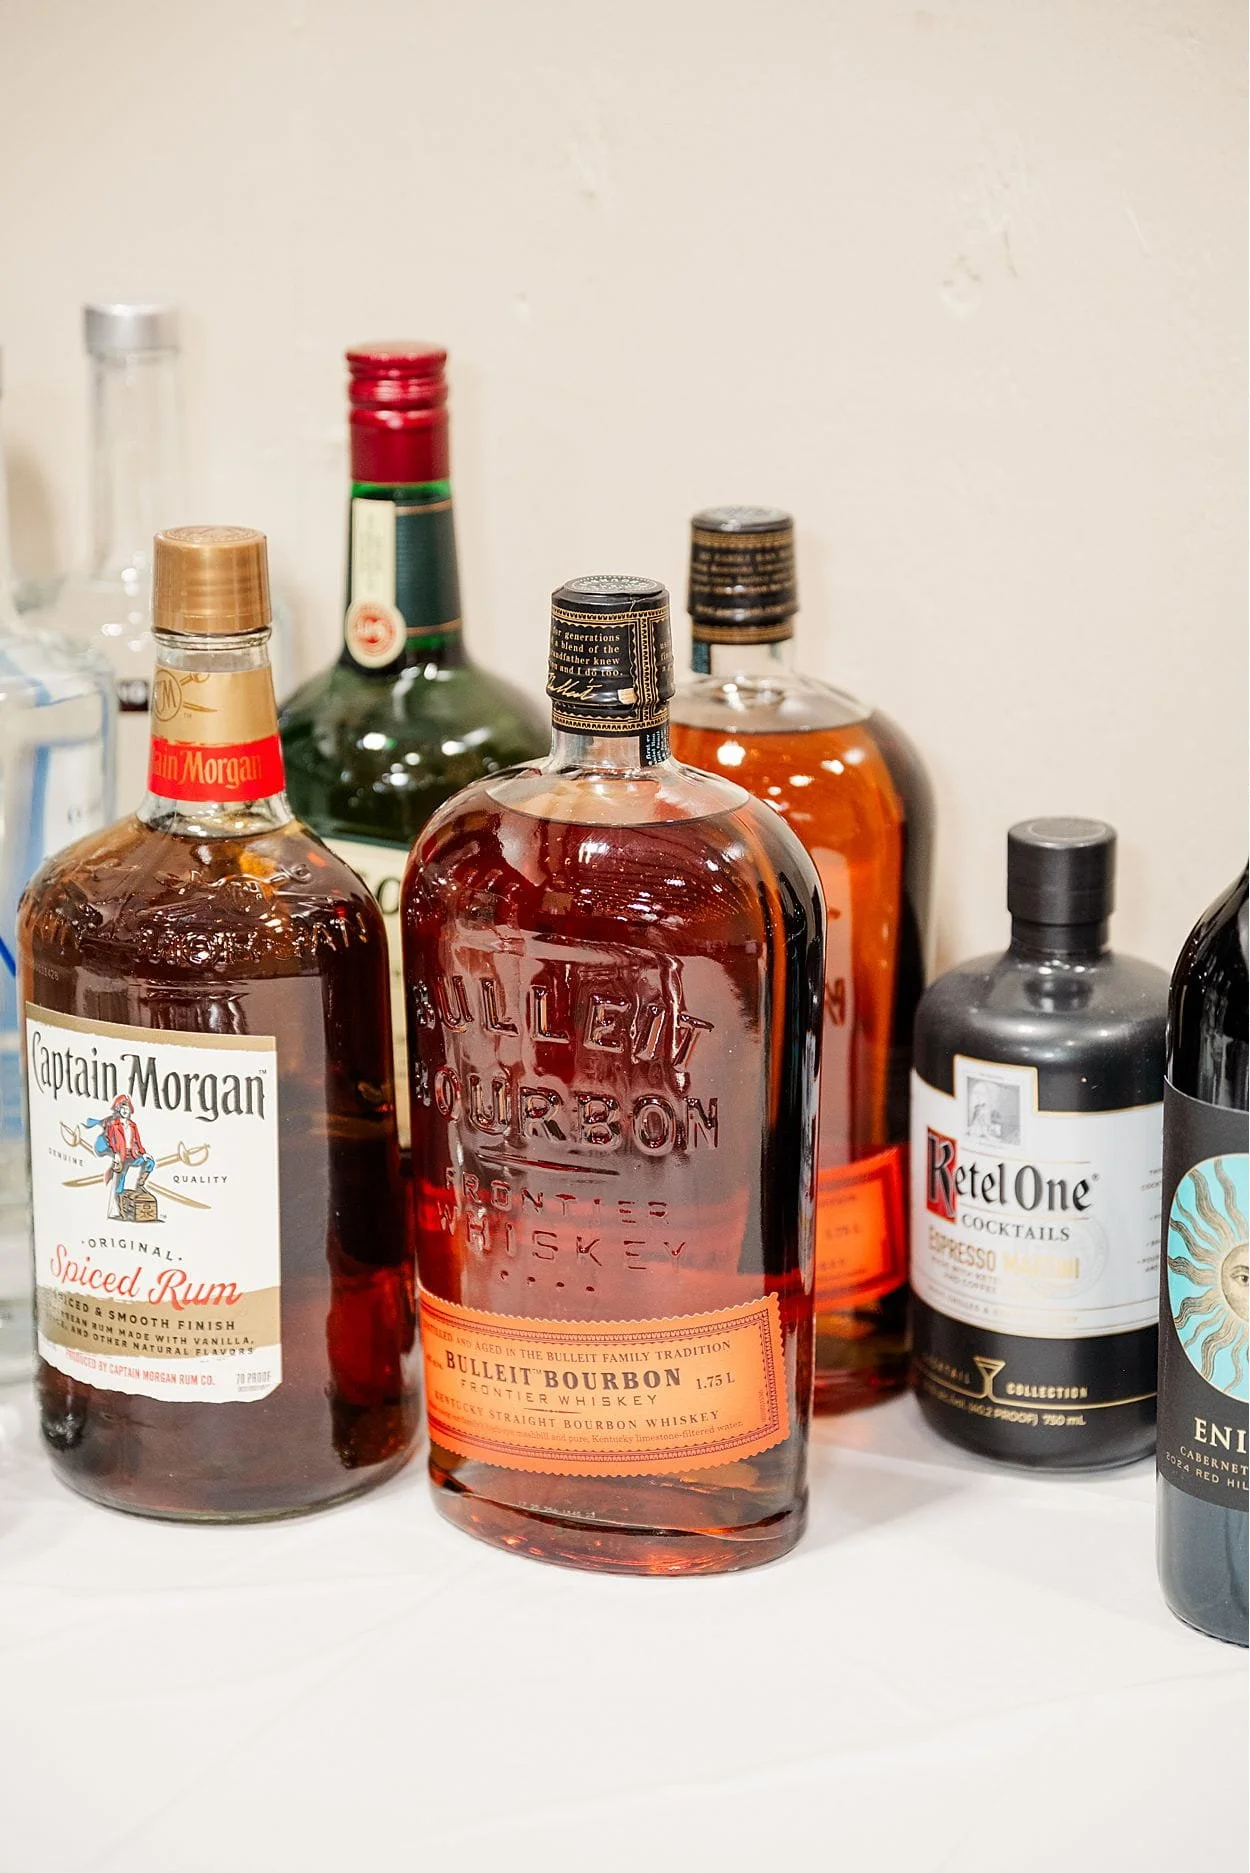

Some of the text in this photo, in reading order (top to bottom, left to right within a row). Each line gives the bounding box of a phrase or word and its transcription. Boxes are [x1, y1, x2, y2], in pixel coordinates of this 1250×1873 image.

[561, 640, 584, 653] blend
[588, 645, 599, 654] of
[603, 645, 620, 653] the
[564, 629, 620, 642] generations
[559, 665, 575, 674] and
[585, 669, 597, 677] do
[593, 655, 620, 666] knew
[177, 750, 263, 789] Morgan
[32, 1031, 266, 1122] Captain Morgan
[172, 1174, 228, 1184] QUALITY
[928, 1136, 1092, 1218] Ketel One
[961, 1213, 1070, 1242] COCKTAILS
[928, 1225, 997, 1272] ESPRESSO
[50, 1243, 244, 1311] Spiced Rum
[95, 1307, 103, 1317] &
[108, 1310, 170, 1329] SMOOTH
[178, 1320, 236, 1331] FINISH
[71, 1326, 89, 1338] AND
[93, 1334, 127, 1348] OTHER
[132, 1340, 190, 1356] NATURAL
[195, 1347, 254, 1356] FLAVORS
[91, 1322, 114, 1335] RUM
[119, 1328, 150, 1341] MADE
[155, 1335, 188, 1345] WITH
[194, 1336, 255, 1346] VANILLA,
[474, 1341, 502, 1357] AGED
[506, 1347, 517, 1357] IN
[521, 1349, 543, 1361] THE
[546, 1351, 597, 1363] BULLEIT
[602, 1351, 651, 1363] FAMILY
[655, 1340, 731, 1361] TRADITION
[109, 1363, 140, 1378] CAPTAIN
[142, 1369, 177, 1384] MORGAN
[179, 1374, 198, 1385] RUM
[200, 1376, 216, 1386] CO.
[445, 1349, 531, 1386] BULLEIT
[543, 1367, 681, 1390] BOURBON
[696, 1371, 736, 1390] 1.75 L
[460, 1379, 657, 1407] FRONTIER WHISKEY
[1005, 1382, 1089, 1399] COLLECTION
[434, 1390, 483, 1417] KENTUCKY
[488, 1410, 557, 1428] STRAIGHT
[563, 1419, 638, 1431] BOURBON
[645, 1409, 719, 1429] WHISKEY
[591, 1433, 633, 1445] Kentucky
[1194, 1416, 1247, 1454] ENI
[1166, 1451, 1190, 1473] 2024
[1195, 1468, 1220, 1484] RED
[1180, 1445, 1249, 1475] CABERNET
